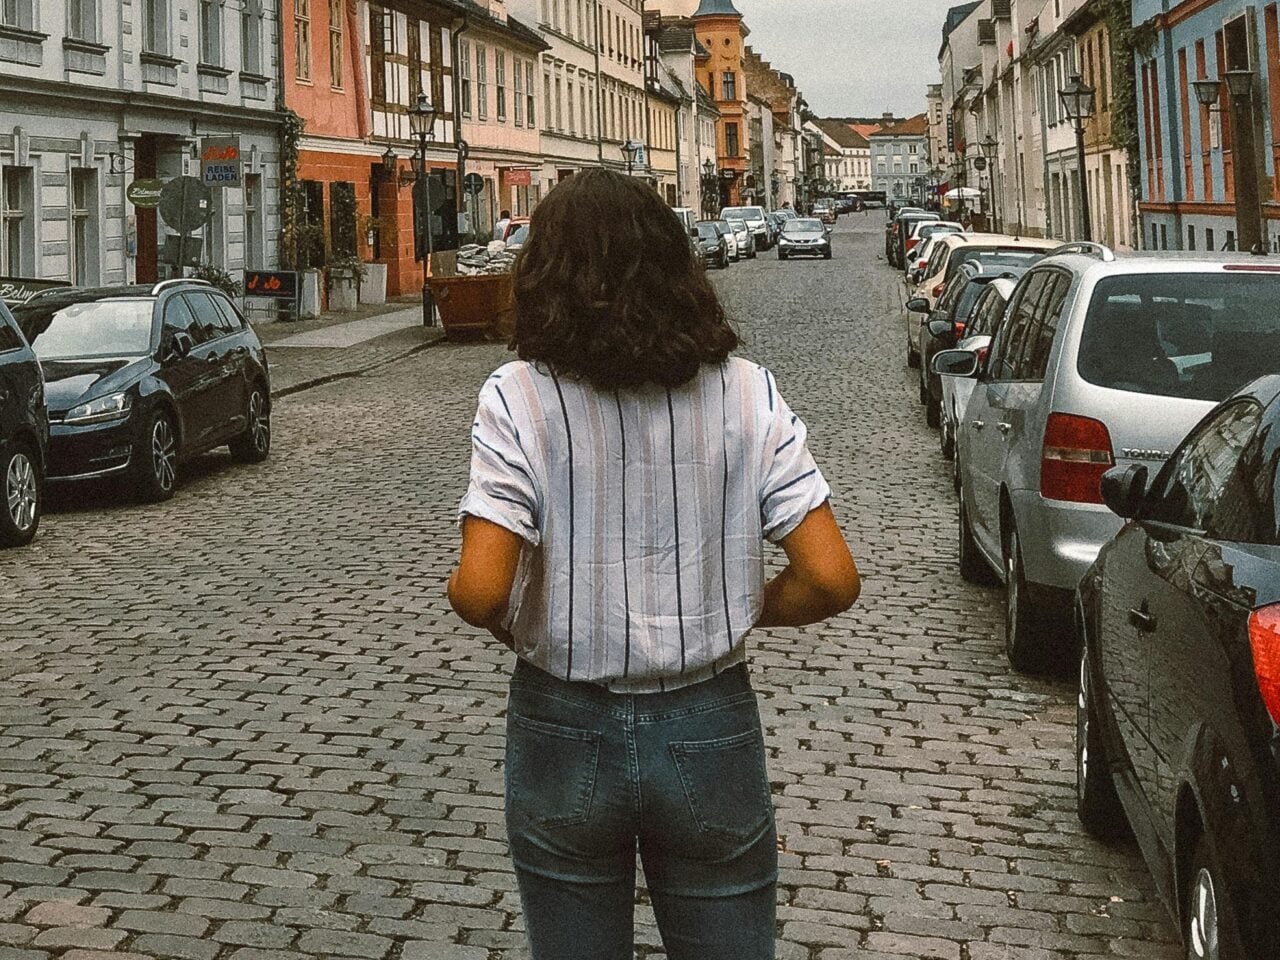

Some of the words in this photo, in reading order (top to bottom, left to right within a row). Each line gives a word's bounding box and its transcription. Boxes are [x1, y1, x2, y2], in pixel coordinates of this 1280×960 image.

[207, 165, 235, 174] REISE
[205, 173, 237, 182] LADEN
[1121, 447, 1171, 460] TOURA
